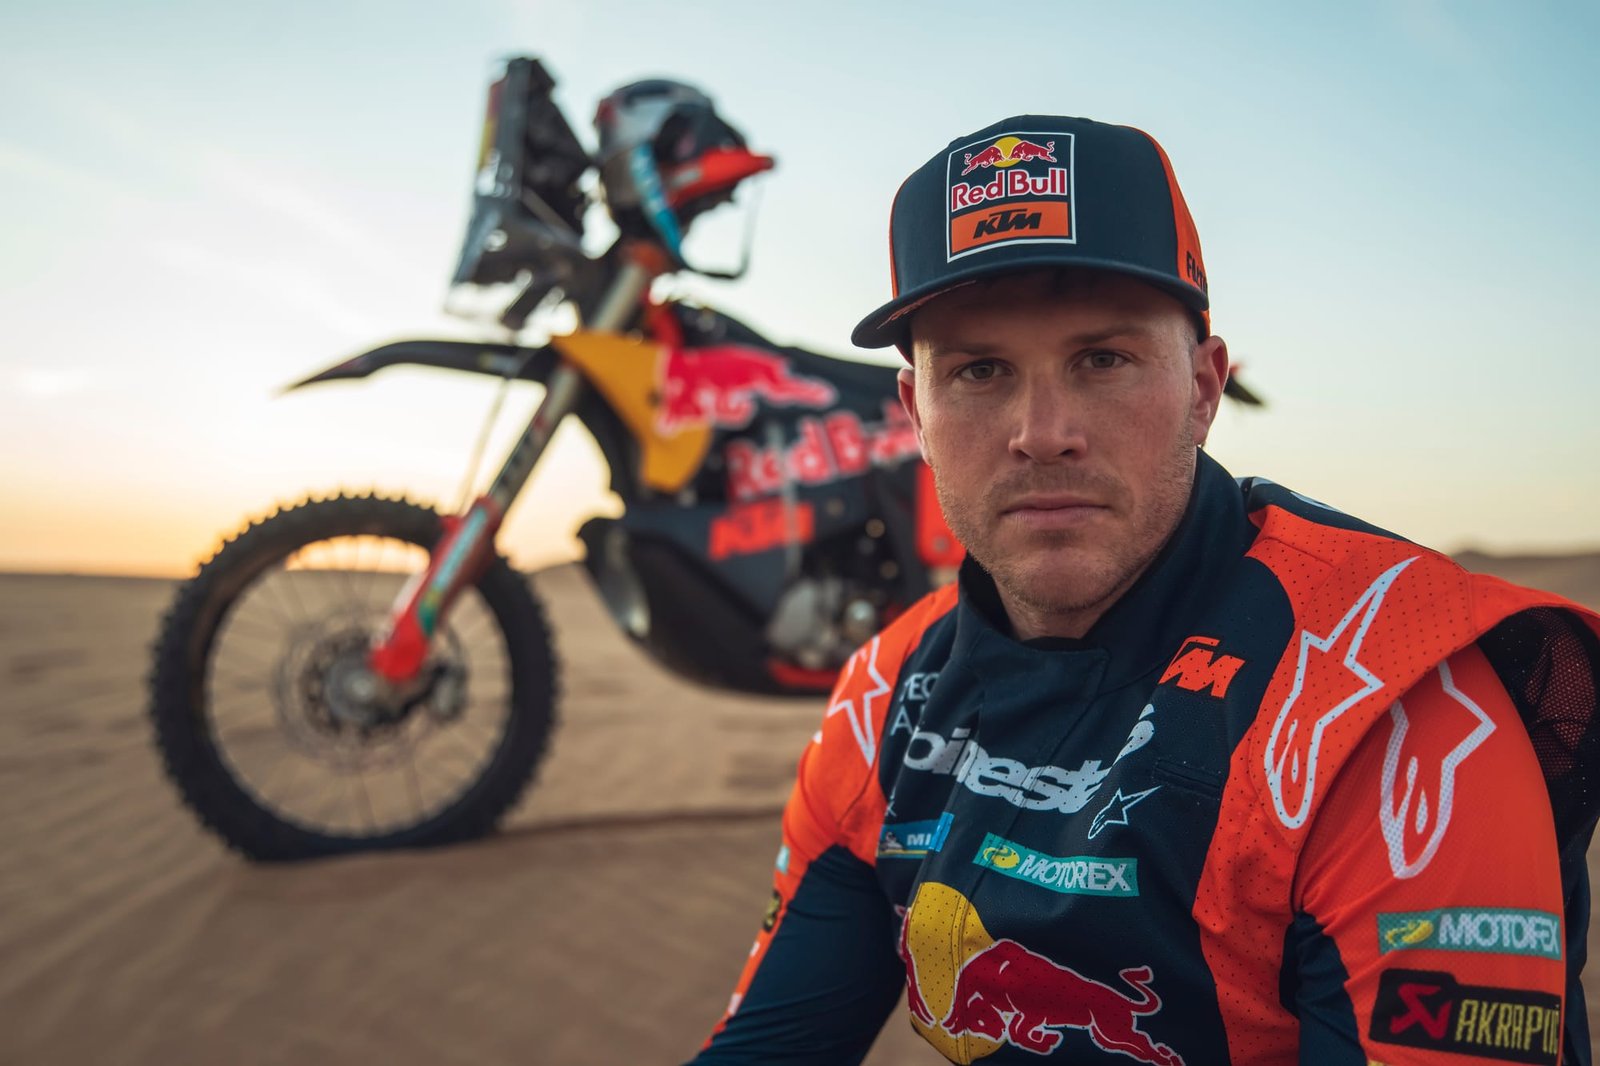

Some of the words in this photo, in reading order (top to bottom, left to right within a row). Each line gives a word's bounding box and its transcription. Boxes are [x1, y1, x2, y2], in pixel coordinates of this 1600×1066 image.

[952, 170, 1005, 213] Red
[1008, 168, 1067, 197] Bull
[973, 208, 1042, 239] KTM
[1158, 635, 1246, 699] TM
[899, 672, 940, 703] TEC
[1016, 853, 1131, 892] MOTOREX
